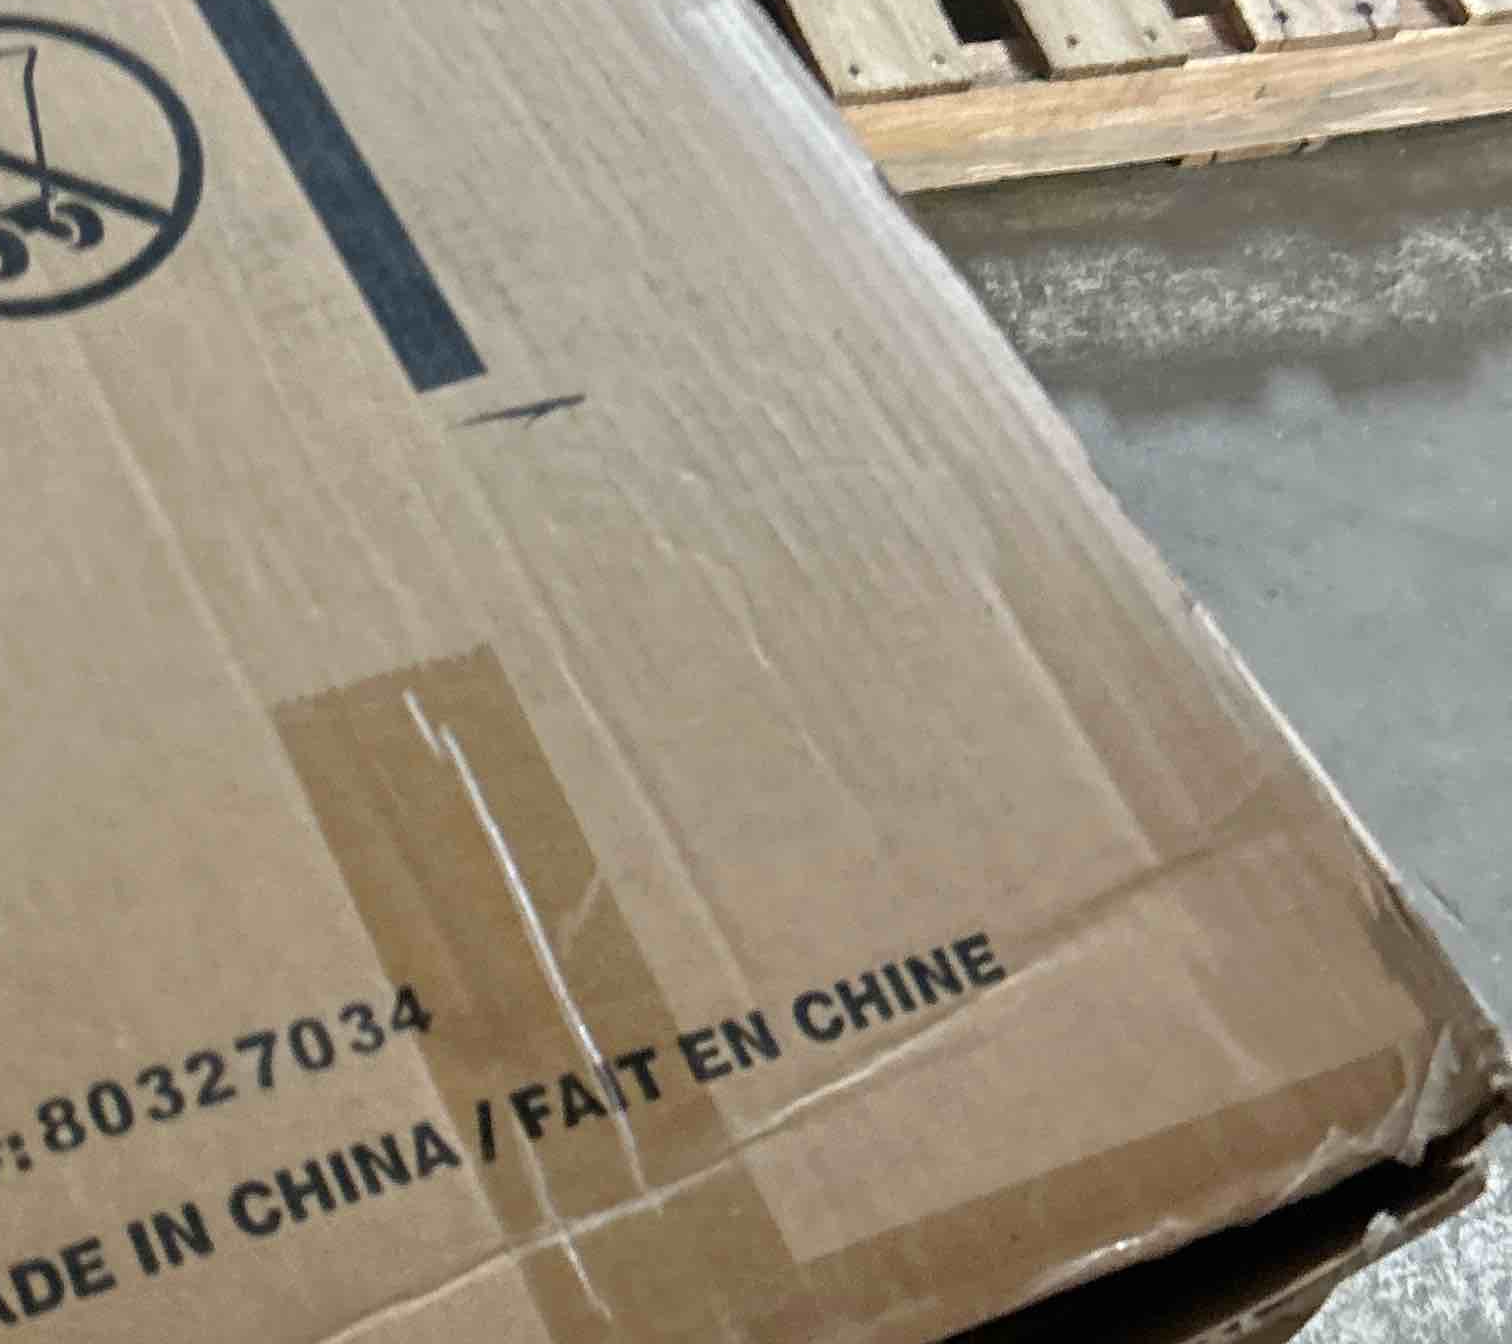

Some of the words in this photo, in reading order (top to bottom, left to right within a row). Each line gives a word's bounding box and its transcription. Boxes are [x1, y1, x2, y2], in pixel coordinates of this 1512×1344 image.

[128, 1202, 215, 1277] IN
[229, 1121, 462, 1238] CHINA
[509, 1047, 662, 1142] FAIT
[677, 1010, 782, 1083] EN
[792, 932, 1007, 1044] CHINE
